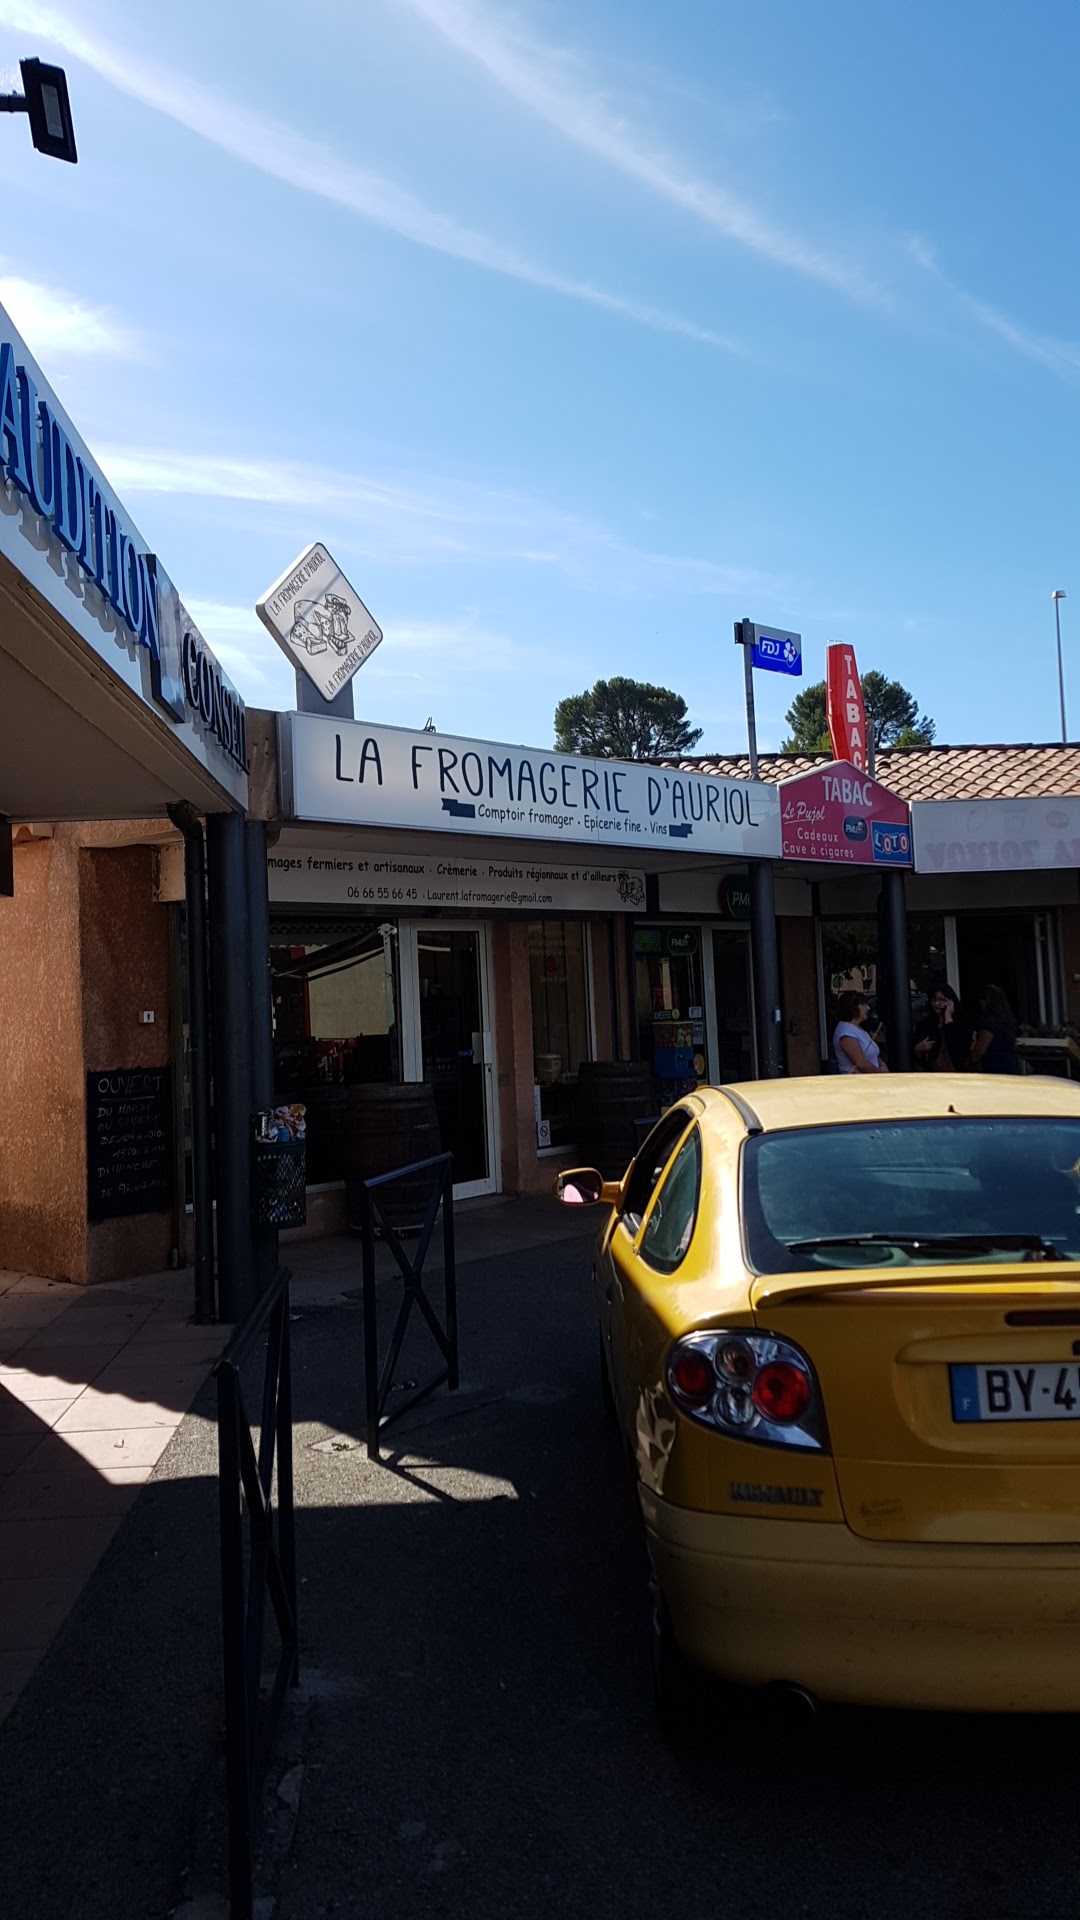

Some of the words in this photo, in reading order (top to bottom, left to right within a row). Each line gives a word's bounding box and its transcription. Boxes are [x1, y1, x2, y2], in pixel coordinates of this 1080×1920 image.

[0, 343, 160, 661] AUDITION
[269, 600, 283, 616] LA
[277, 569, 309, 609] FROMAGERIE
[761, 640, 780, 655] FDJ
[325, 678, 336, 695] LA
[844, 655, 862, 769] TABAC
[335, 734, 383, 785] LA
[412, 745, 630, 813] FROMAGERIE
[647, 776, 759, 827] D'AURIOL
[821, 775, 873, 807] TABAC
[478, 803, 525, 823] Comptoir
[528, 808, 575, 829] fromager
[584, 814, 621, 832] Epicerie
[623, 818, 641, 832] fine
[650, 821, 667, 834] Vins
[782, 801, 796, 820] Le
[797, 801, 826, 825] Pujol
[797, 827, 839, 843] Cadeaux
[845, 824, 858, 834] PMU
[782, 841, 807, 855] Cave
[811, 843, 817, 855] à
[820, 844, 854, 859] cigares
[874, 832, 909, 853] LOTO
[267, 858, 303, 872] mages
[307, 856, 354, 871] fermiers
[357, 861, 370, 871] et
[373, 861, 425, 874] artisanaux
[488, 865, 523, 879] Produits
[526, 867, 568, 882] régionnaux
[571, 870, 580, 881] et
[582, 870, 617, 882] d'ailleurs
[347, 886, 360, 898] 06
[362, 886, 375, 899] 66
[377, 887, 390, 899] 55
[391, 888, 404, 899] 66
[406, 888, 418, 900] 45
[427, 889, 553, 906] Laurent.lafromagerie@gmail.com
[97, 1075, 164, 1095] OUVERT
[96, 1107, 113, 1118] DU
[97, 1121, 113, 1132] AU
[100, 1135, 116, 1145] DE
[985, 1368, 1080, 1414] BY-4
[961, 1398, 972, 1411] F
